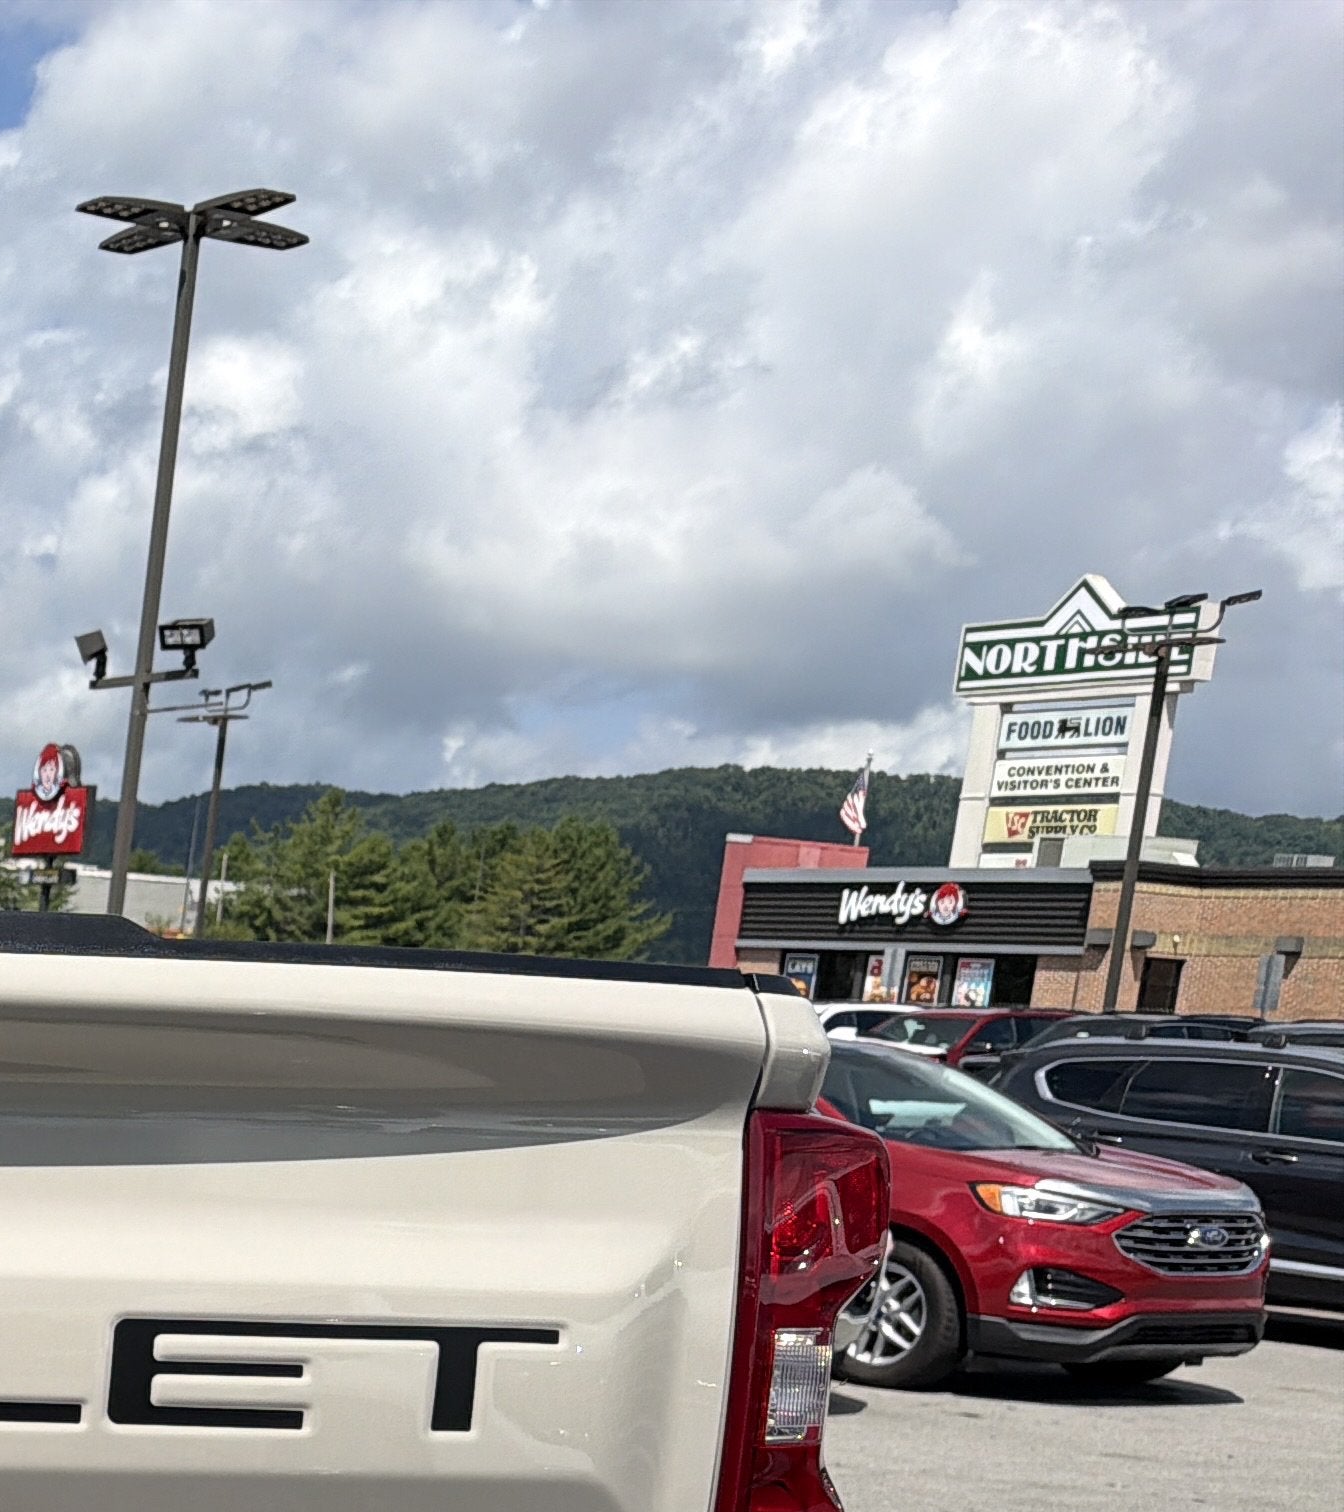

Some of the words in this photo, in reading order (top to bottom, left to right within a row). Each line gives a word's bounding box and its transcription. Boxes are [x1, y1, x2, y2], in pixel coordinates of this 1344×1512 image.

[1005, 719, 1055, 742] FOOD
[1083, 715, 1128, 738] LION
[1007, 763, 1096, 777] CONVENTION
[1099, 762, 1110, 774] &
[996, 777, 1061, 791] VISITOR'S
[1064, 776, 1120, 789] CENTER
[14, 794, 80, 846] Wendy's
[1030, 808, 1100, 824] TRACTOR
[838, 880, 927, 925] Wendy's
